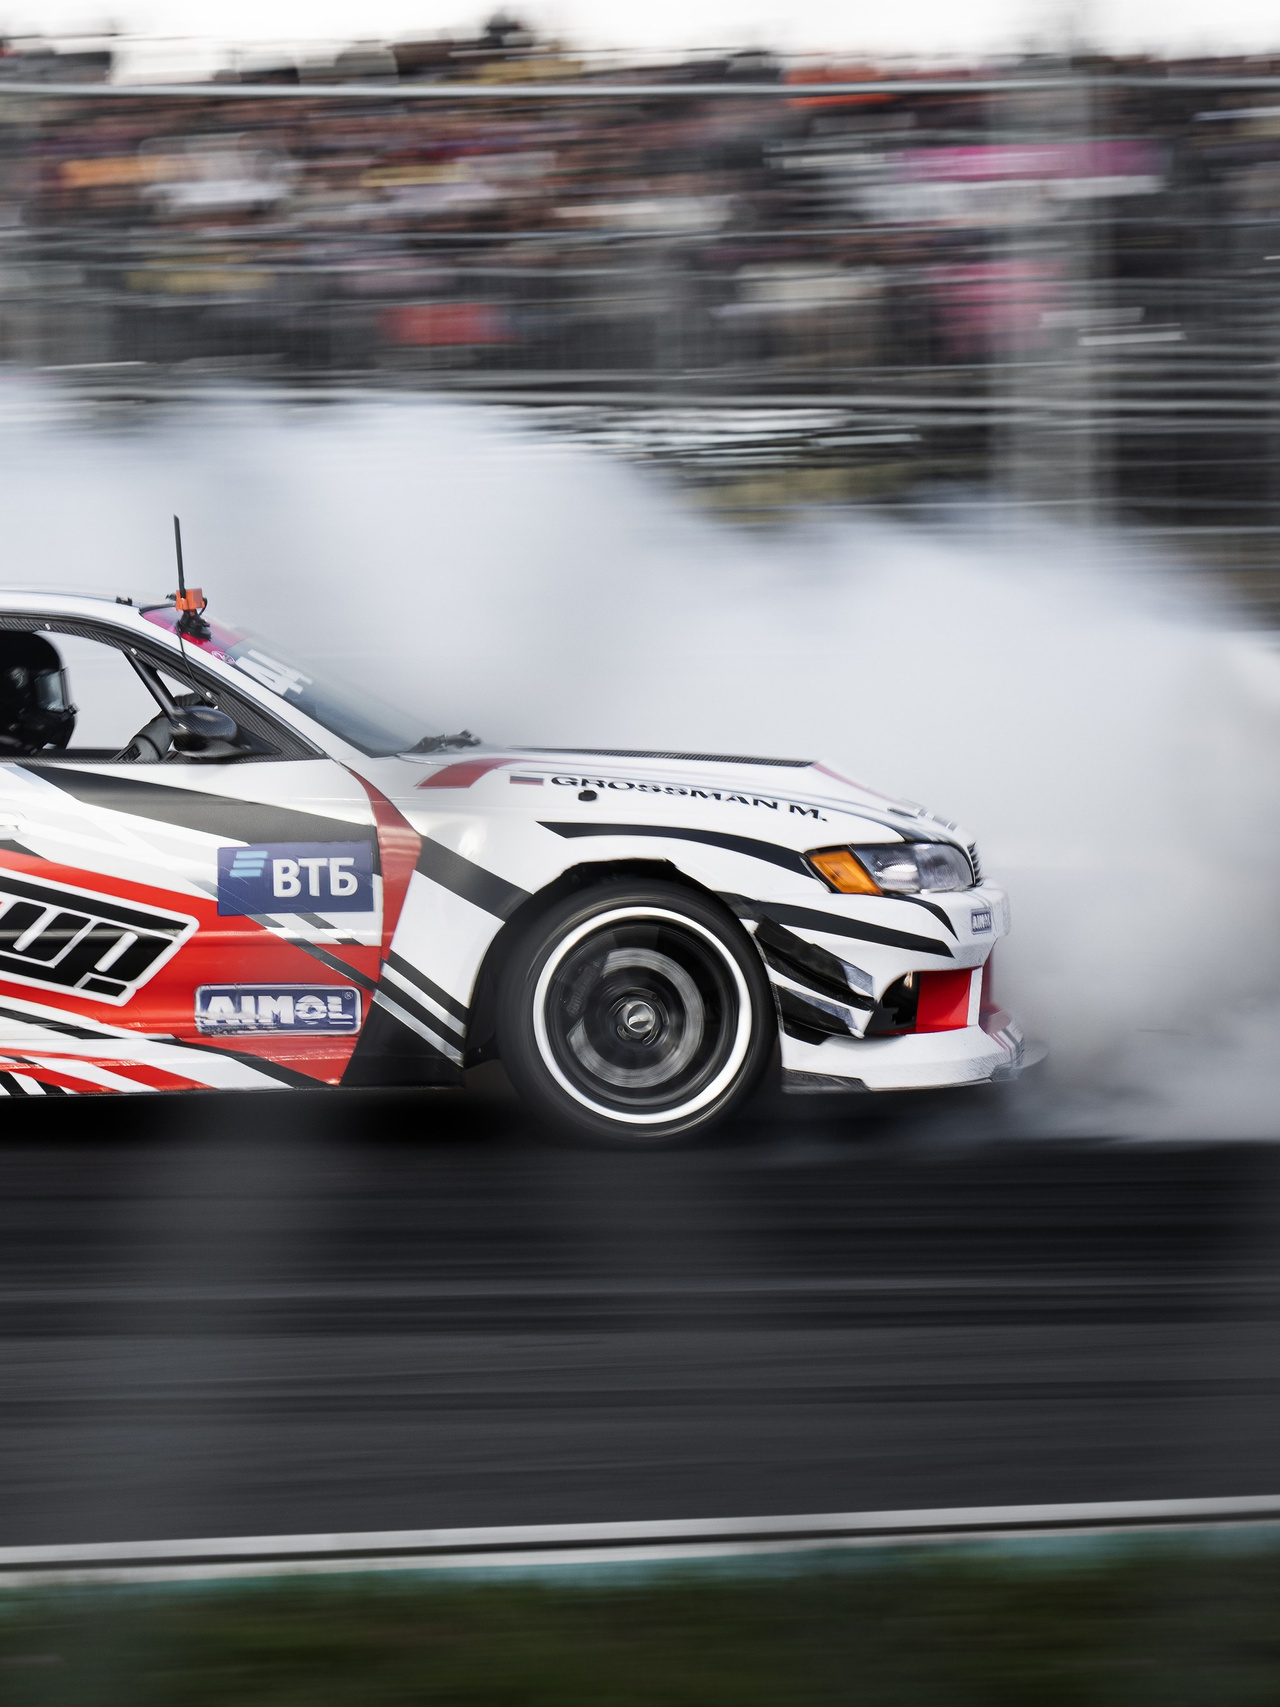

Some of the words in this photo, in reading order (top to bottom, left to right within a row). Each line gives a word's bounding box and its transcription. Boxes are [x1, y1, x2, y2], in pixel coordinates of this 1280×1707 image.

[551, 775, 778, 810] GROSSMAN
[787, 803, 828, 823] M.
[272, 856, 359, 898] ВТБ
[202, 994, 354, 1027] AIMOL
